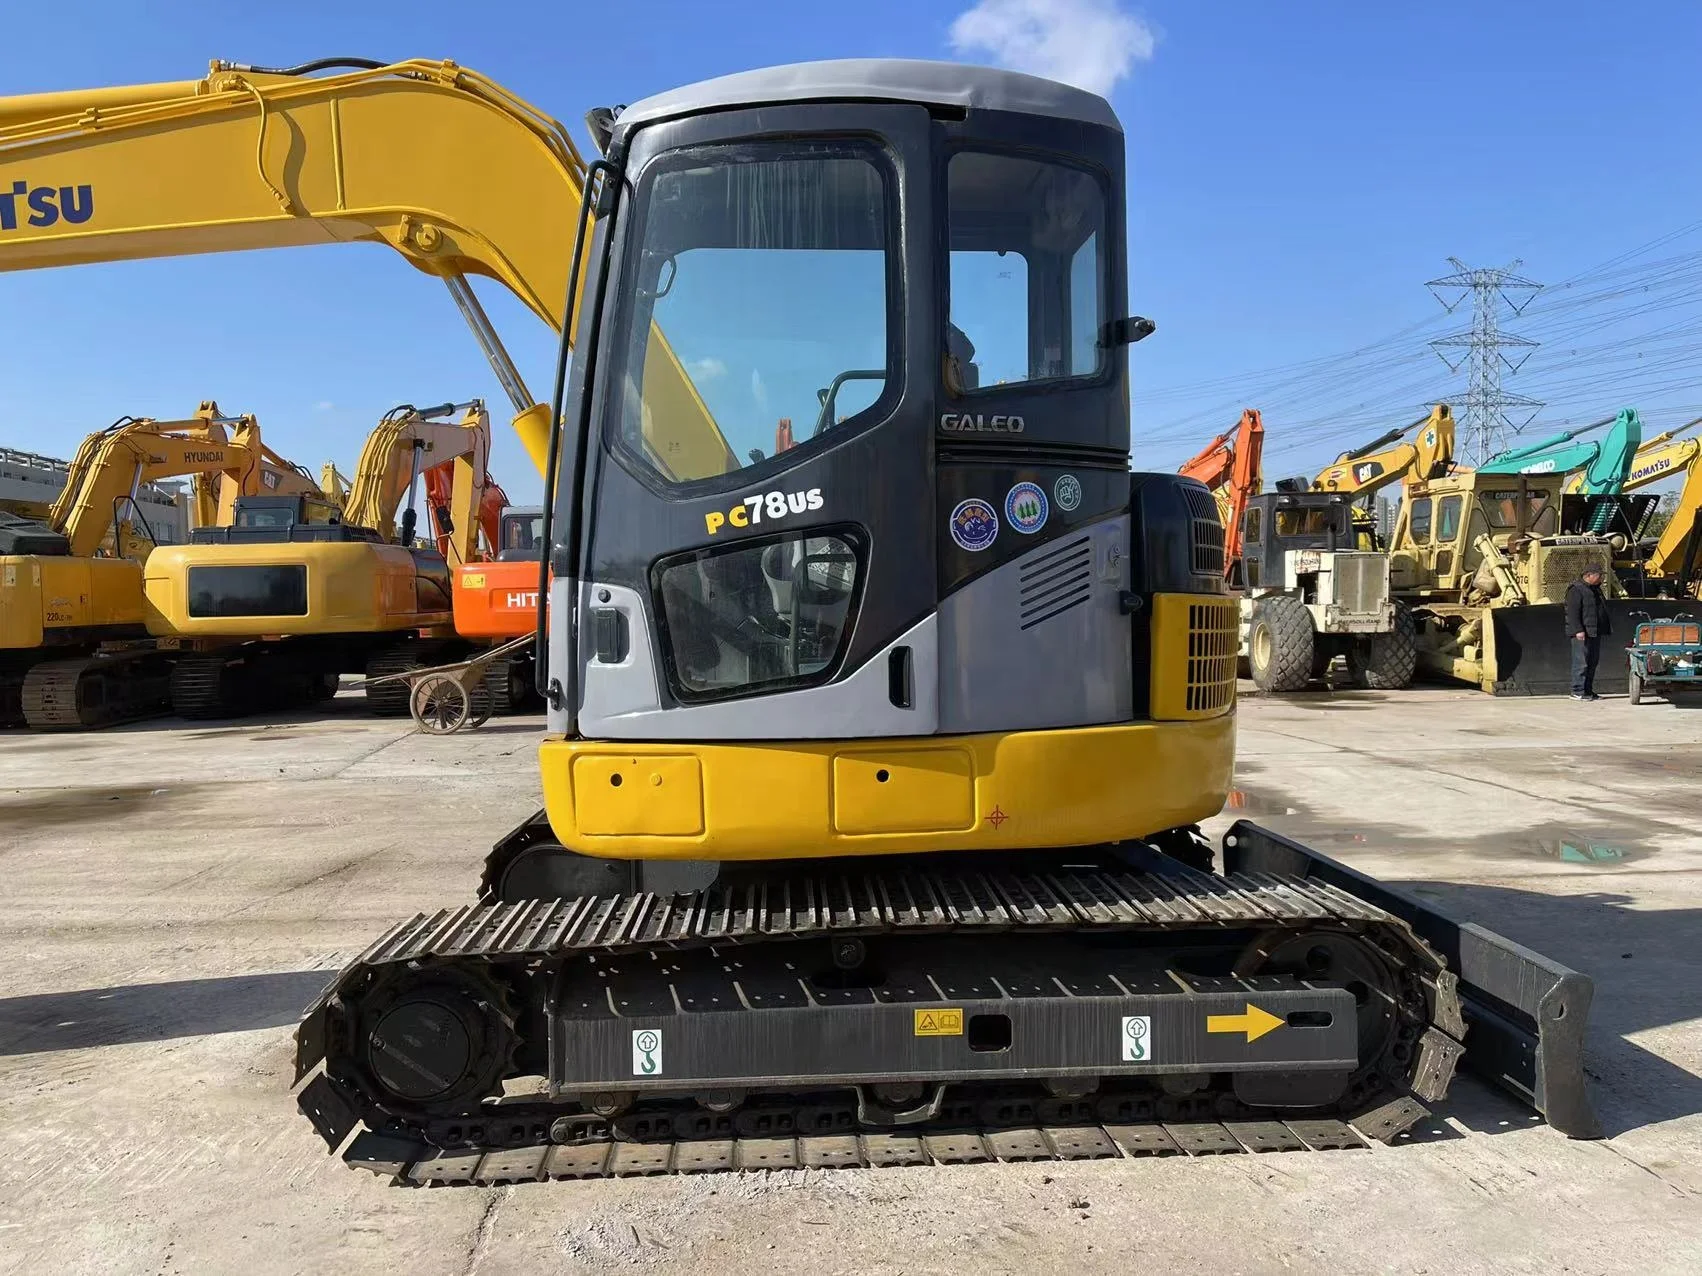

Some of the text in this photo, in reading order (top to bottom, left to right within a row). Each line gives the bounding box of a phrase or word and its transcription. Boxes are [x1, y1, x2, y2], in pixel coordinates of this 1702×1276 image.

[941, 414, 1024, 433] GALEO
[184, 451, 224, 463] HYUNDAI
[1359, 464, 1372, 483] CAT
[1631, 458, 1670, 480] KOMATSU
[264, 472, 277, 488] CAT
[705, 488, 824, 535] PC78US
